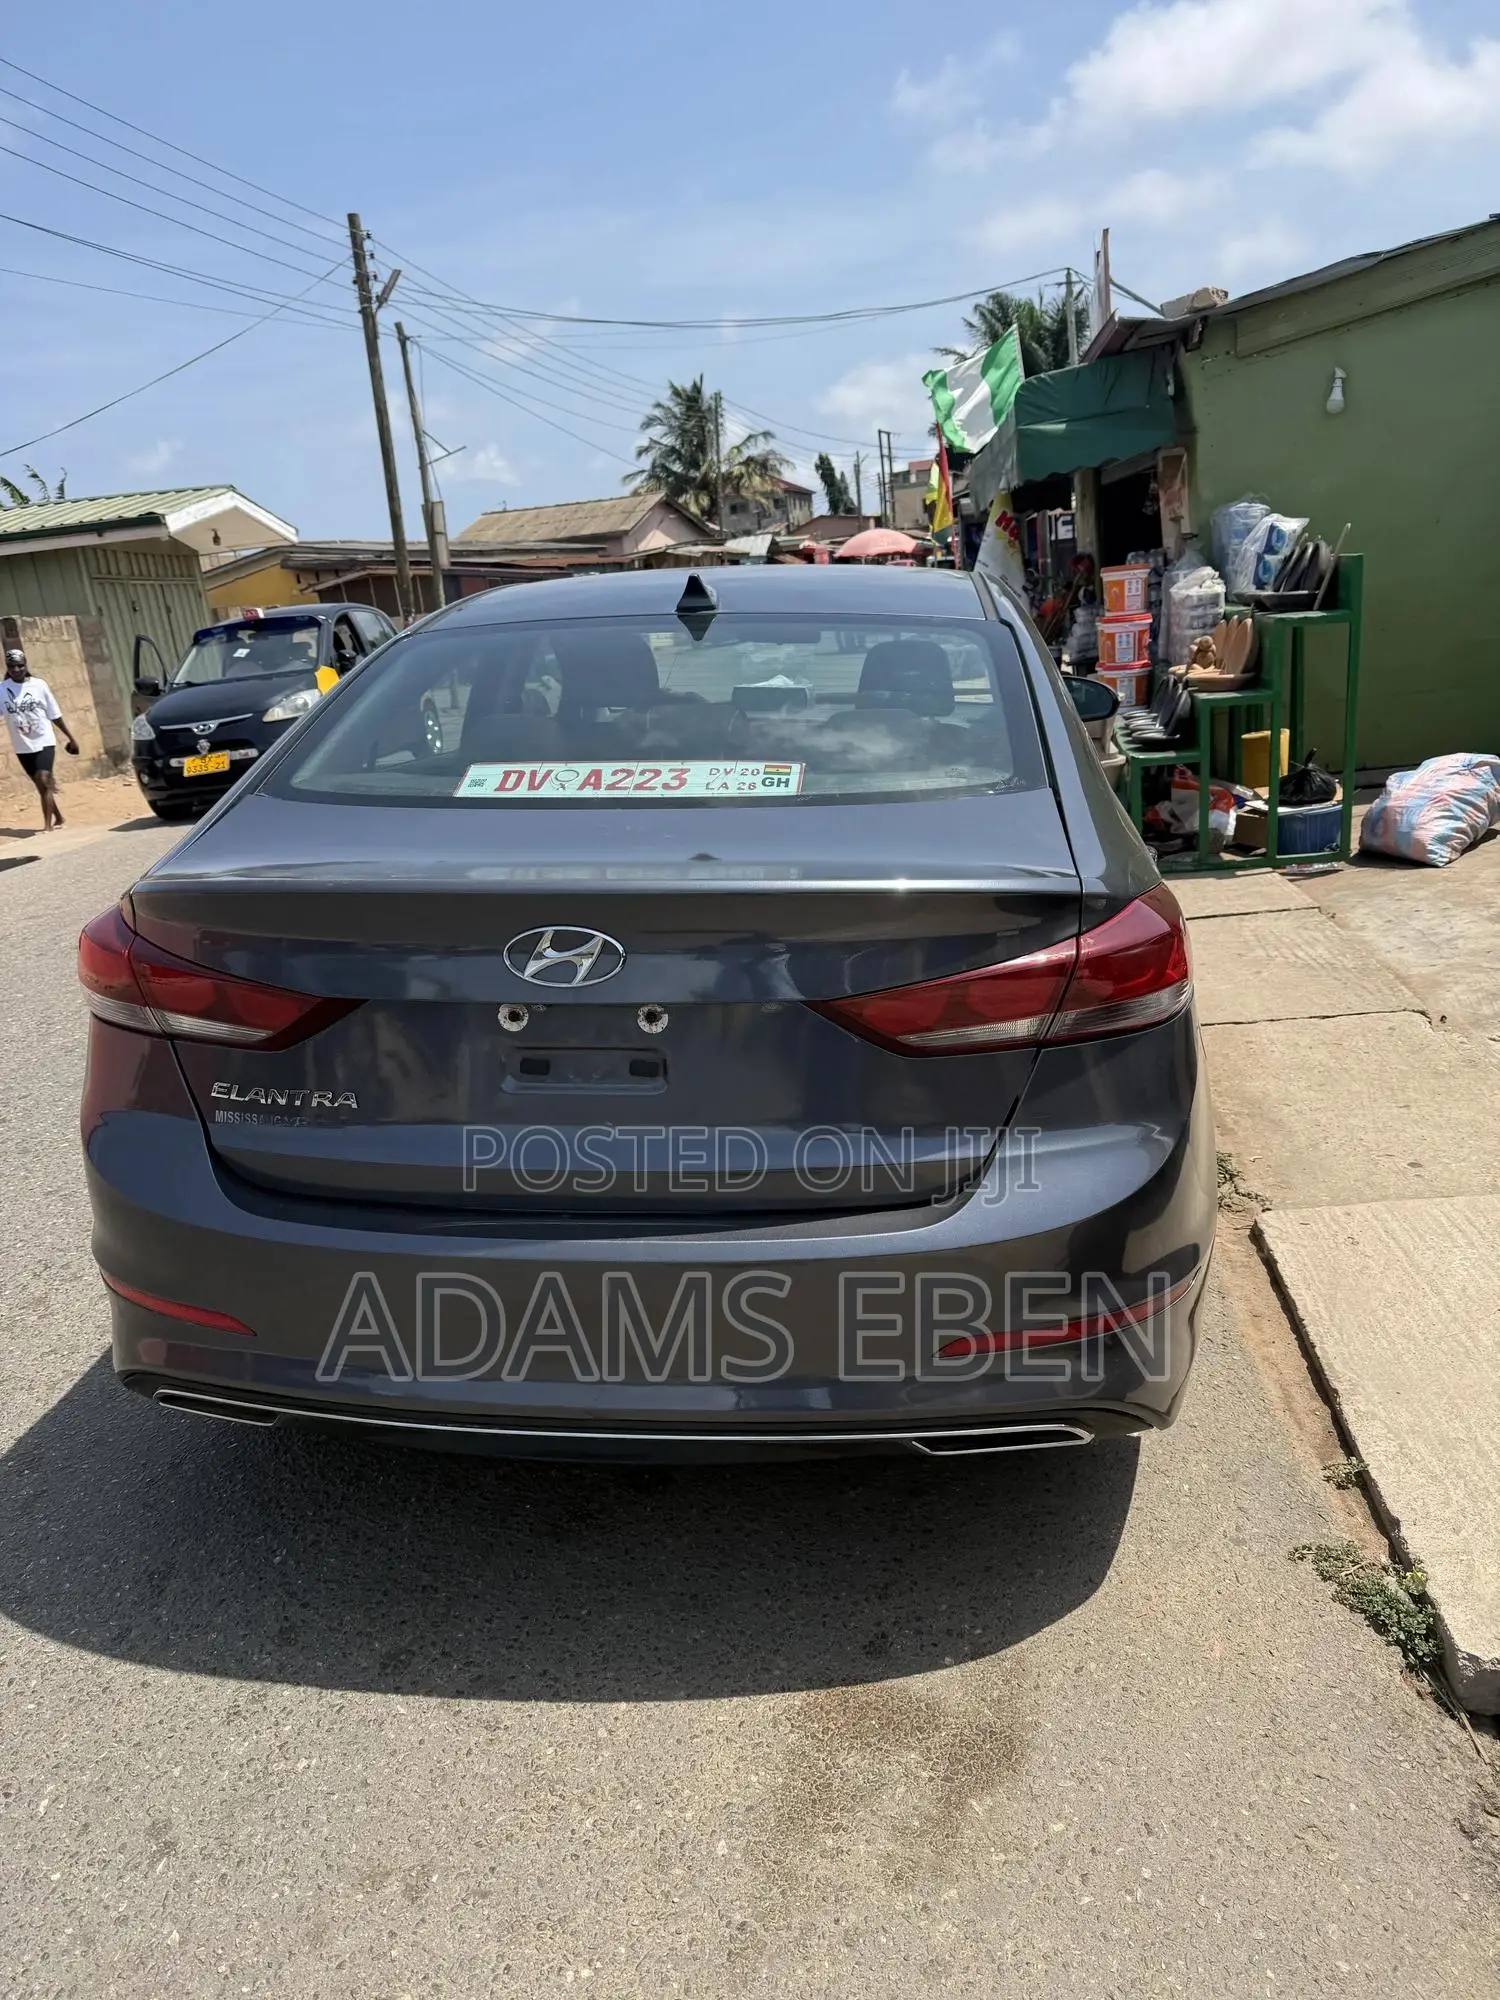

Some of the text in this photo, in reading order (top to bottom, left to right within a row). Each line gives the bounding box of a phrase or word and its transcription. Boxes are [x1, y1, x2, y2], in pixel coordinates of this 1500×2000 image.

[494, 768, 691, 791] DV A223
[761, 777, 790, 788] GH
[211, 1081, 358, 1109] ELANTRA
